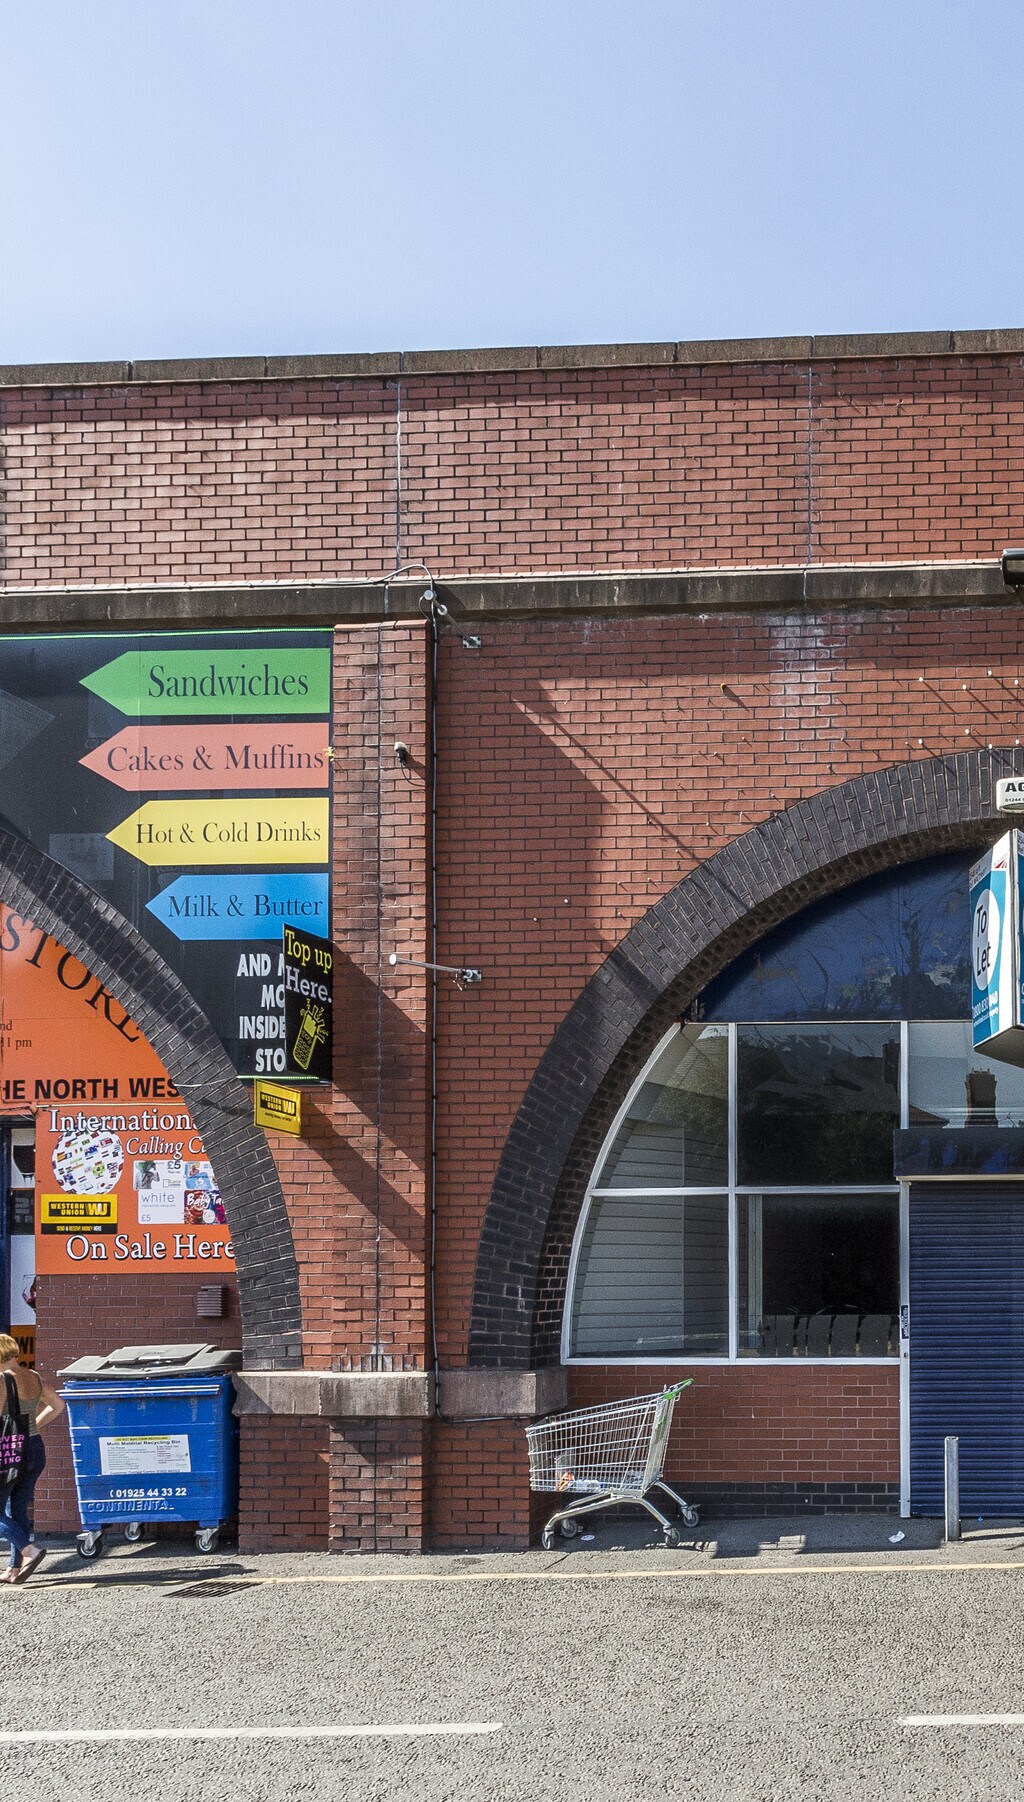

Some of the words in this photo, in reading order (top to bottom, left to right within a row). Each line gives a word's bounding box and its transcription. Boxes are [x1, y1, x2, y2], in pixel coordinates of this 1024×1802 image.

[149, 664, 309, 697] Sandwiches
[107, 747, 183, 772] Cakes
[193, 746, 214, 770] &
[225, 744, 324, 770] Muffins
[137, 823, 174, 843] Hot
[180, 823, 195, 843] &
[203, 822, 248, 843] Cold
[257, 821, 321, 841] Drinks
[168, 895, 220, 917] Milk
[227, 895, 245, 916] &
[255, 894, 322, 916] Butter
[977, 905, 986, 937] To
[286, 929, 311, 966] Top
[315, 949, 332, 974] up
[977, 942, 991, 976] Let
[237, 954, 271, 976] AND
[286, 965, 332, 1003] Here.
[239, 1016, 285, 1039] INSIDE
[15, 1039, 32, 1050] pm
[35, 1079, 118, 1099] NORTH
[49, 1109, 197, 1132] Internation
[126, 1136, 184, 1160] Calling
[167, 1160, 181, 1169] £5
[141, 1193, 175, 1203] white
[187, 1193, 210, 1209] Baby
[66, 1235, 107, 1260] On
[114, 1233, 166, 1259] Sale
[173, 1234, 235, 1259] Here
[116, 1489, 145, 1497] 01925
[147, 1488, 159, 1496] 44
[161, 1488, 173, 1496] 33
[175, 1488, 187, 1496] 22
[87, 1501, 174, 1512] CONTINENTAL
